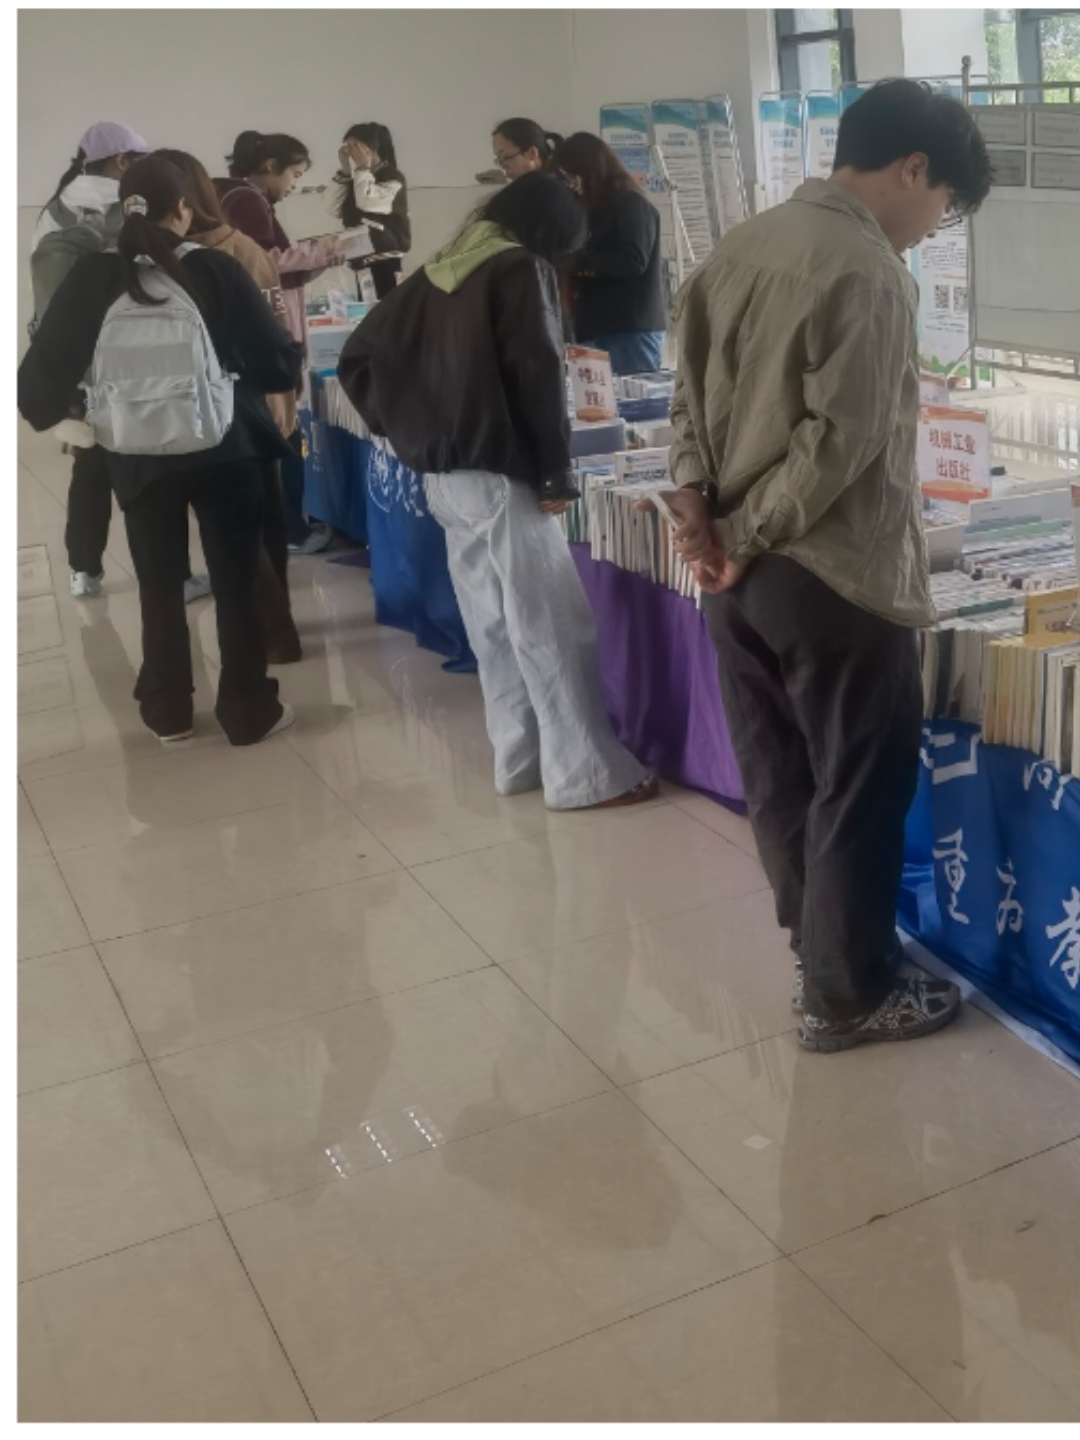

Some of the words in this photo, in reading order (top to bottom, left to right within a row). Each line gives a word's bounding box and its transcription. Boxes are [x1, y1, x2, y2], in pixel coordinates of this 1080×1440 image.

[929, 427, 976, 456] 机械工业
[936, 459, 970, 483] 出版社
